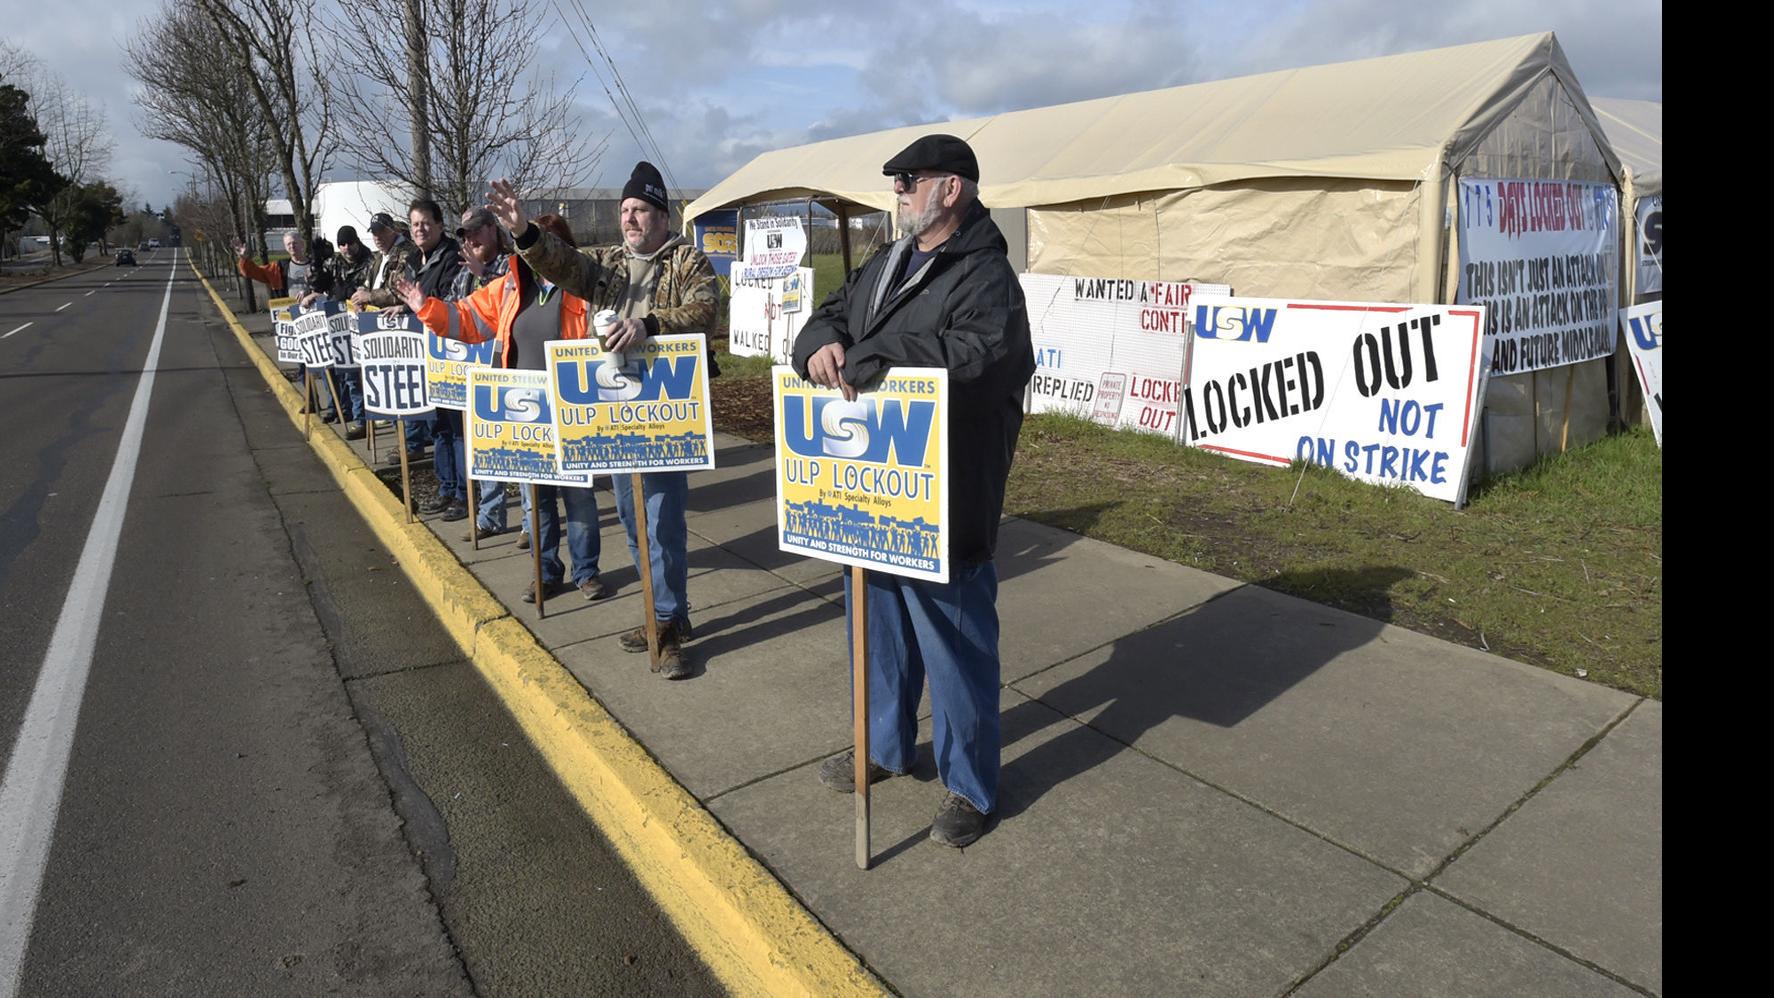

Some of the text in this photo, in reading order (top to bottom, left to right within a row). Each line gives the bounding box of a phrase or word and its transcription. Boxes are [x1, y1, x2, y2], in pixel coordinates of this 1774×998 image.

[1498, 182, 1528, 236] DAYS
[1529, 182, 1565, 232] LOCKED
[1567, 183, 1585, 231] OUT
[1074, 278, 1134, 300] WANTED
[1140, 281, 1148, 302] A
[1466, 261, 1495, 299] THIS
[1498, 259, 1524, 295] ISN'T
[1528, 257, 1549, 293] JUST
[1552, 255, 1565, 289] AN
[1565, 253, 1596, 288] ATTACK
[1196, 305, 1277, 343] USW
[1502, 298, 1512, 333] IS
[1515, 296, 1529, 332] AN
[1532, 292, 1569, 329] ATTACK
[1571, 291, 1583, 325] ON
[429, 361, 446, 373] ULP
[555, 346, 599, 357] UNITED
[1036, 348, 1062, 369] ATI
[1491, 339, 1517, 373] AND
[1520, 331, 1559, 370] FUTURE
[475, 374, 509, 383] UNITED
[556, 355, 698, 404] USW
[1033, 375, 1094, 402] REPLIED
[1184, 314, 1441, 441] LOCKED OUT
[561, 402, 700, 426] ULP LOCKOUT
[1139, 406, 1177, 431] OUT
[1378, 398, 1443, 439] NOT
[475, 423, 503, 439] ULP
[784, 395, 936, 467] USW
[494, 469, 509, 477] AND
[510, 470, 539, 479] STRENGTH
[566, 462, 589, 470] UNITY
[649, 458, 664, 466] FOR
[666, 457, 705, 466] WORKERS
[1297, 436, 1449, 485] ON STRIKE
[786, 458, 934, 500] ULP LOCKOUT
[845, 492, 871, 505] Specialty
[873, 496, 892, 508] Alloys
[787, 535, 934, 571] UNITY AND STRENGTH FOR WORKERS
